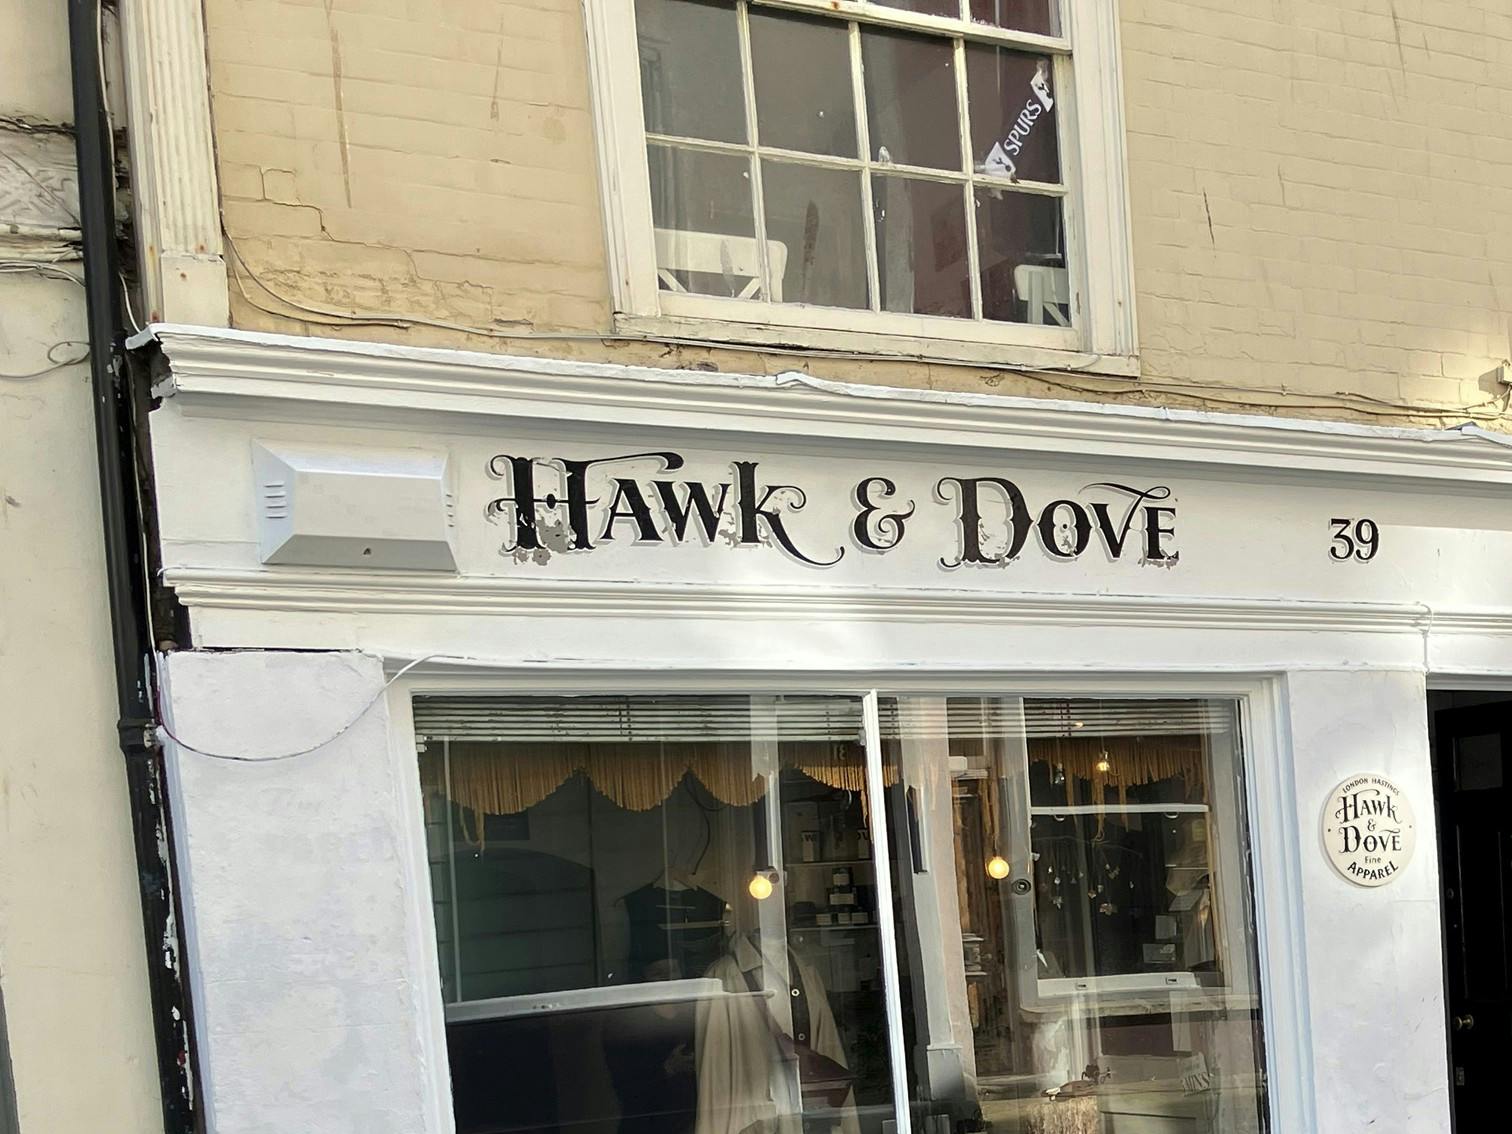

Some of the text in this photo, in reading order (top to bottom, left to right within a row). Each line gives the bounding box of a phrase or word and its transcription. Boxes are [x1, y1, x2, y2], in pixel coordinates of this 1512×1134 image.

[1004, 99, 1042, 156] SPURS
[486, 452, 1180, 568] HAWK & DOVE
[1328, 518, 1380, 562] 39
[1343, 778, 1369, 793] LONDON
[1367, 818, 1376, 831] &
[1338, 825, 1402, 853] DOVE
[1347, 860, 1399, 880] APPAREL
[1364, 856, 1382, 864] Fine
